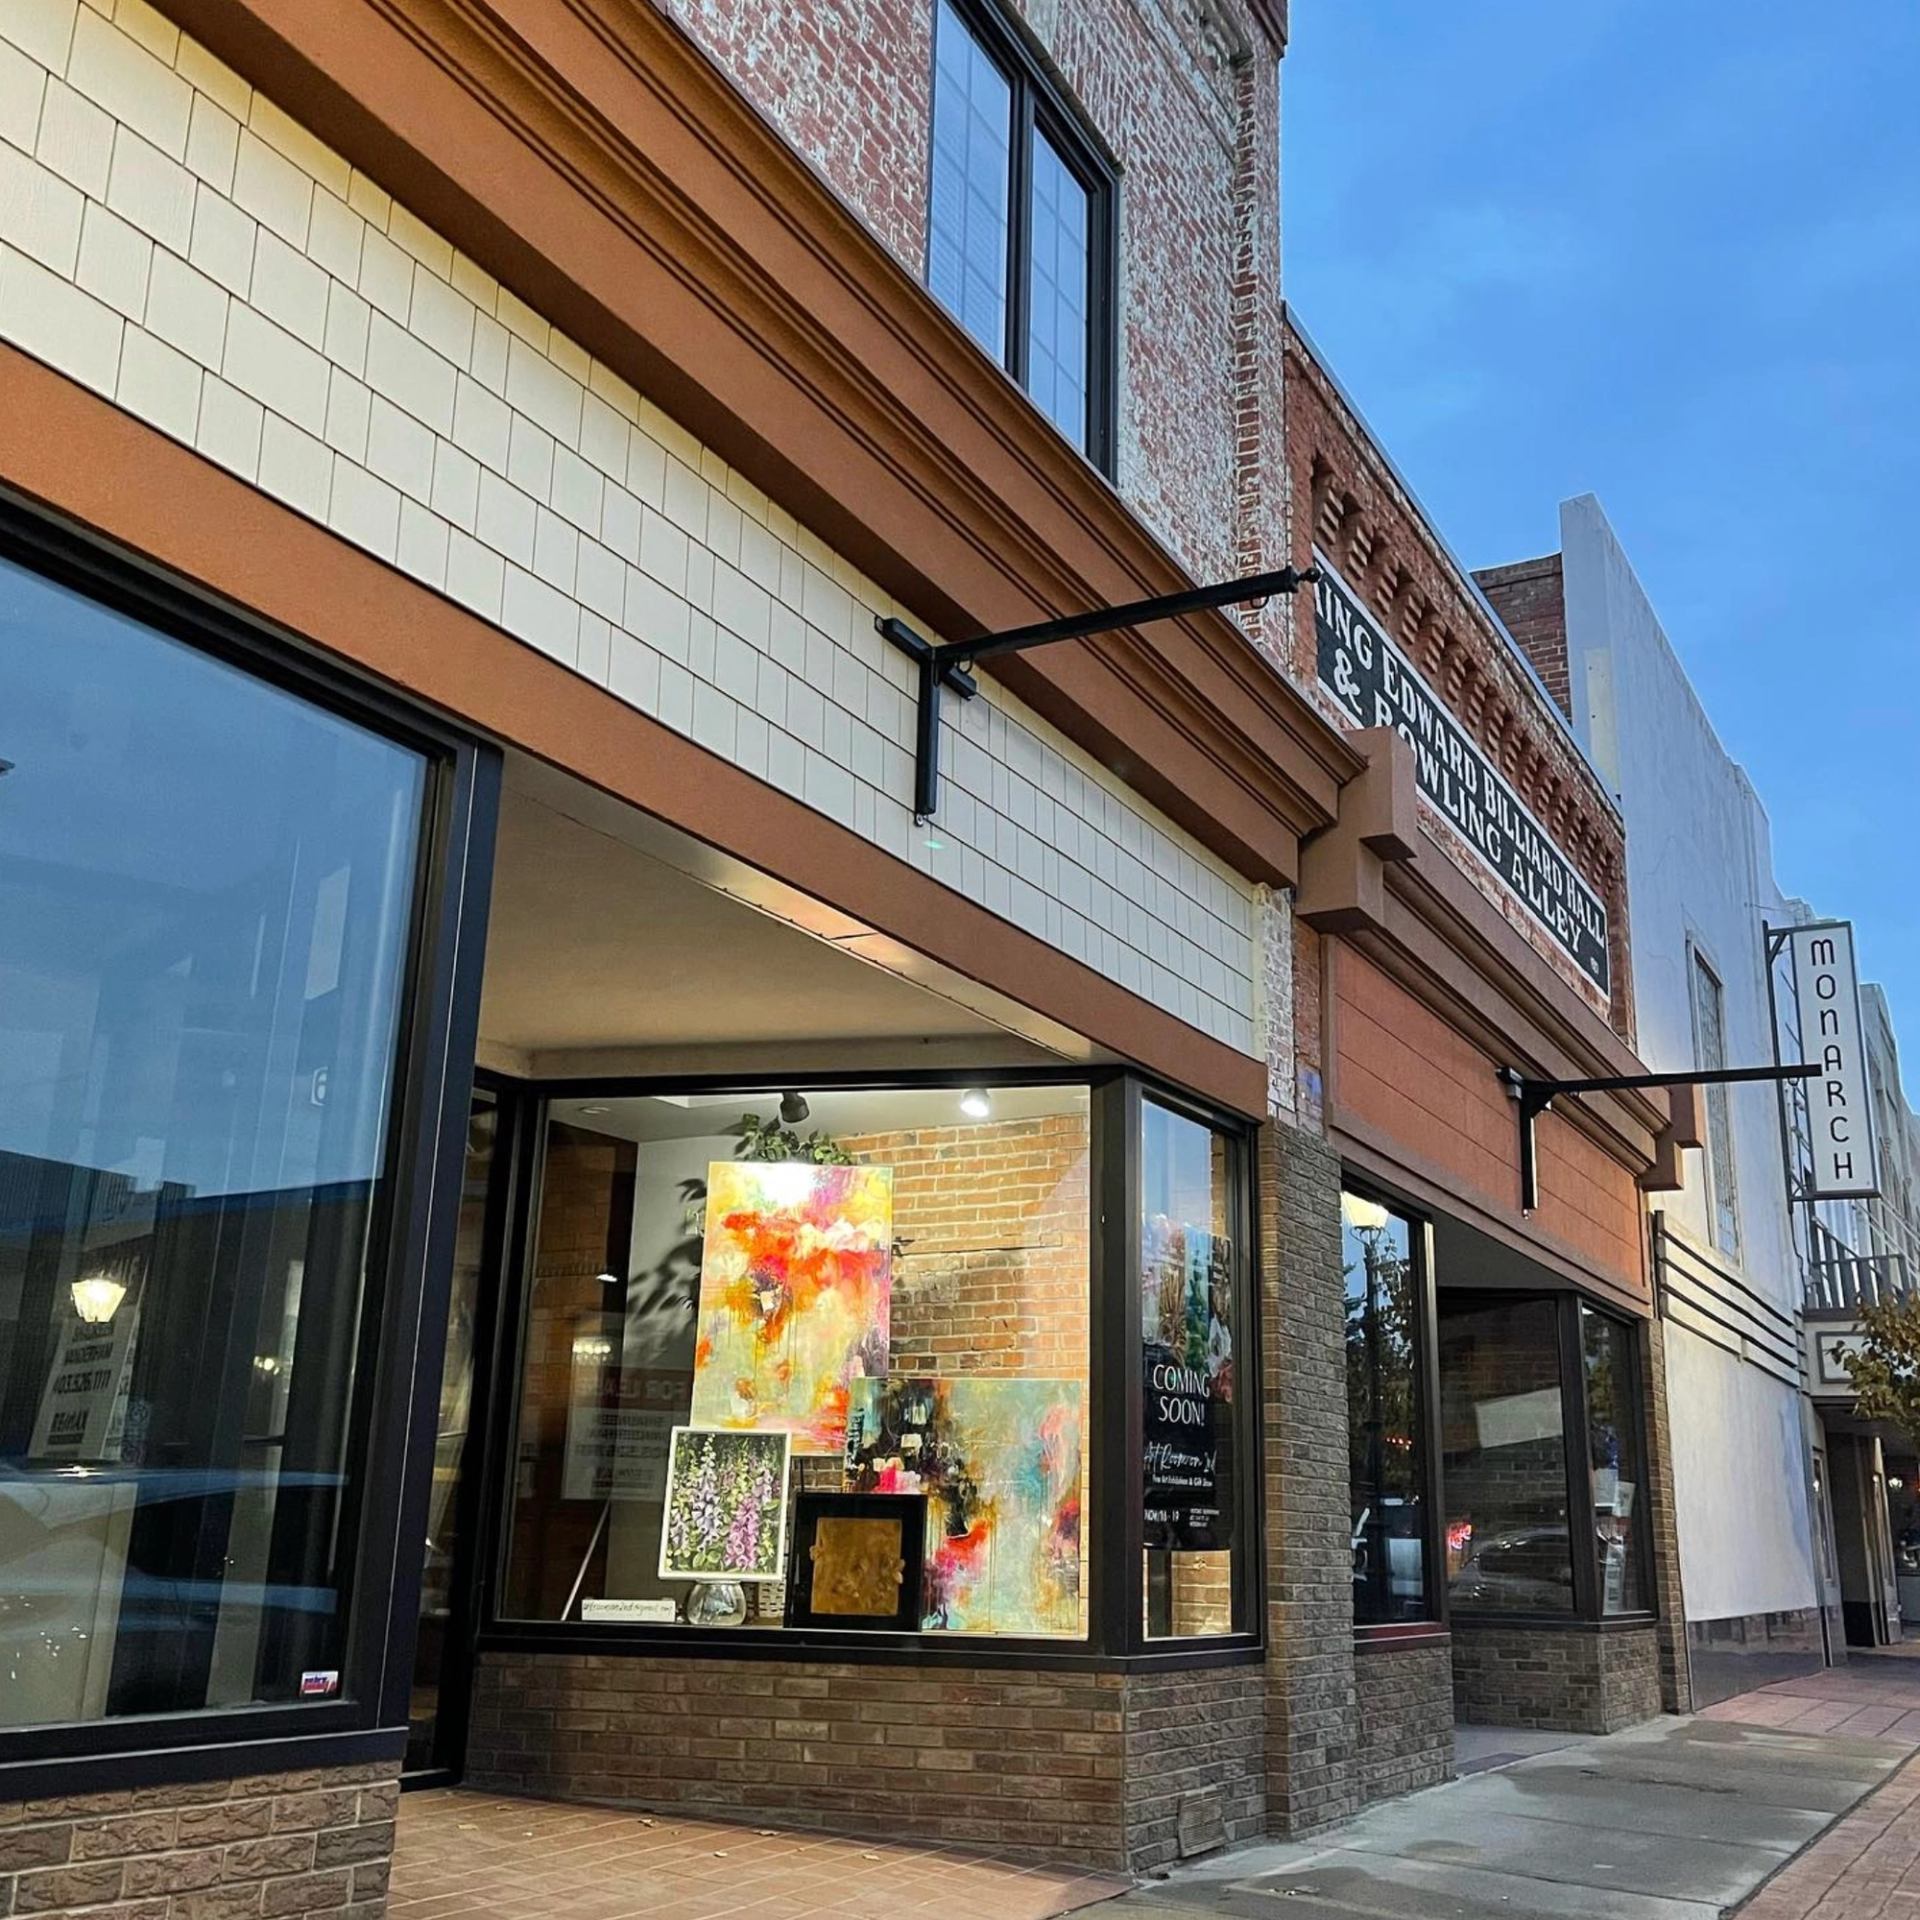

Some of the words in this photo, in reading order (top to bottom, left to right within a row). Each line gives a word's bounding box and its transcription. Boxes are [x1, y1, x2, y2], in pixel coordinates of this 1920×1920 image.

[1333, 647, 1362, 716] &
[1511, 853, 1582, 953] ALLEY
[1382, 646, 1477, 795] EDWARD
[1483, 768, 1562, 896] BILLIARD
[1565, 871, 1605, 949] HALL
[1153, 1364, 1210, 1398] COMING
[1158, 1395, 1205, 1426] SOON!
